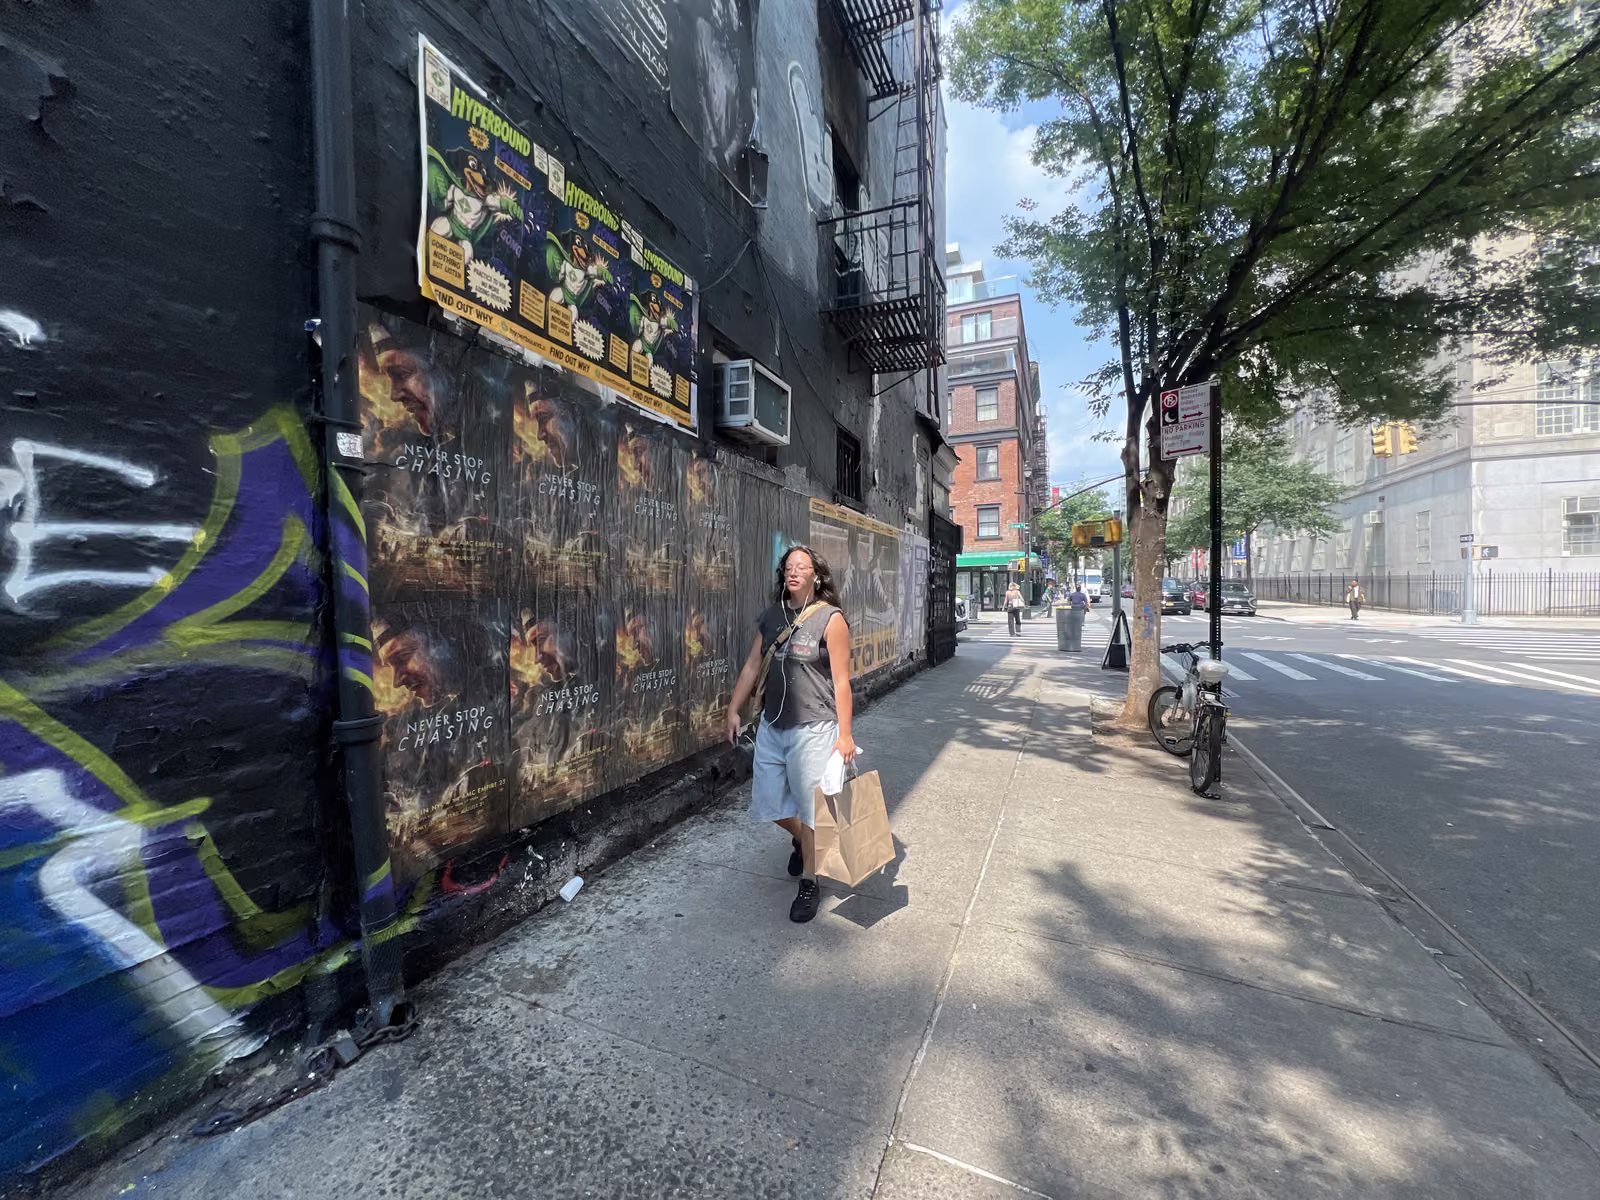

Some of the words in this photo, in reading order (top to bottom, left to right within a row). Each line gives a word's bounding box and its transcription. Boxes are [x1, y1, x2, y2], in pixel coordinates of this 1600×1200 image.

[451, 87, 531, 157] HYPERBOUND
[564, 181, 619, 231] HYPERBOUND
[432, 260, 443, 269] BUT
[445, 266, 462, 279] LISTEN
[433, 250, 461, 269] NOTHING
[643, 248, 684, 286] HYPERBOUND
[434, 289, 454, 306] FIND
[456, 300, 473, 315] OUT
[475, 308, 493, 324] WHY
[550, 346, 564, 360] FIND
[565, 354, 577, 367] OUT
[578, 360, 590, 373] WHY
[1176, 421, 1205, 432] PARKING
[404, 443, 448, 463] NEVER
[454, 453, 484, 469] STOP
[395, 455, 492, 485] CHASING
[538, 483, 601, 506] CHASING
[544, 473, 573, 488] NEVER
[576, 480, 597, 493] STOP
[635, 504, 678, 521] CHASING
[639, 496, 659, 508] NEVER
[661, 501, 675, 511] STOP
[636, 671, 656, 682] NEVER
[658, 669, 672, 678] STOP
[696, 665, 728, 679] CHASING
[541, 688, 572, 702] NEVER
[573, 683, 594, 696] STOP
[632, 675, 676, 693] CHASING
[536, 691, 599, 717] CHASING
[407, 714, 450, 734] NEVER
[456, 706, 486, 722] STOP
[398, 715, 493, 752] CHASING
